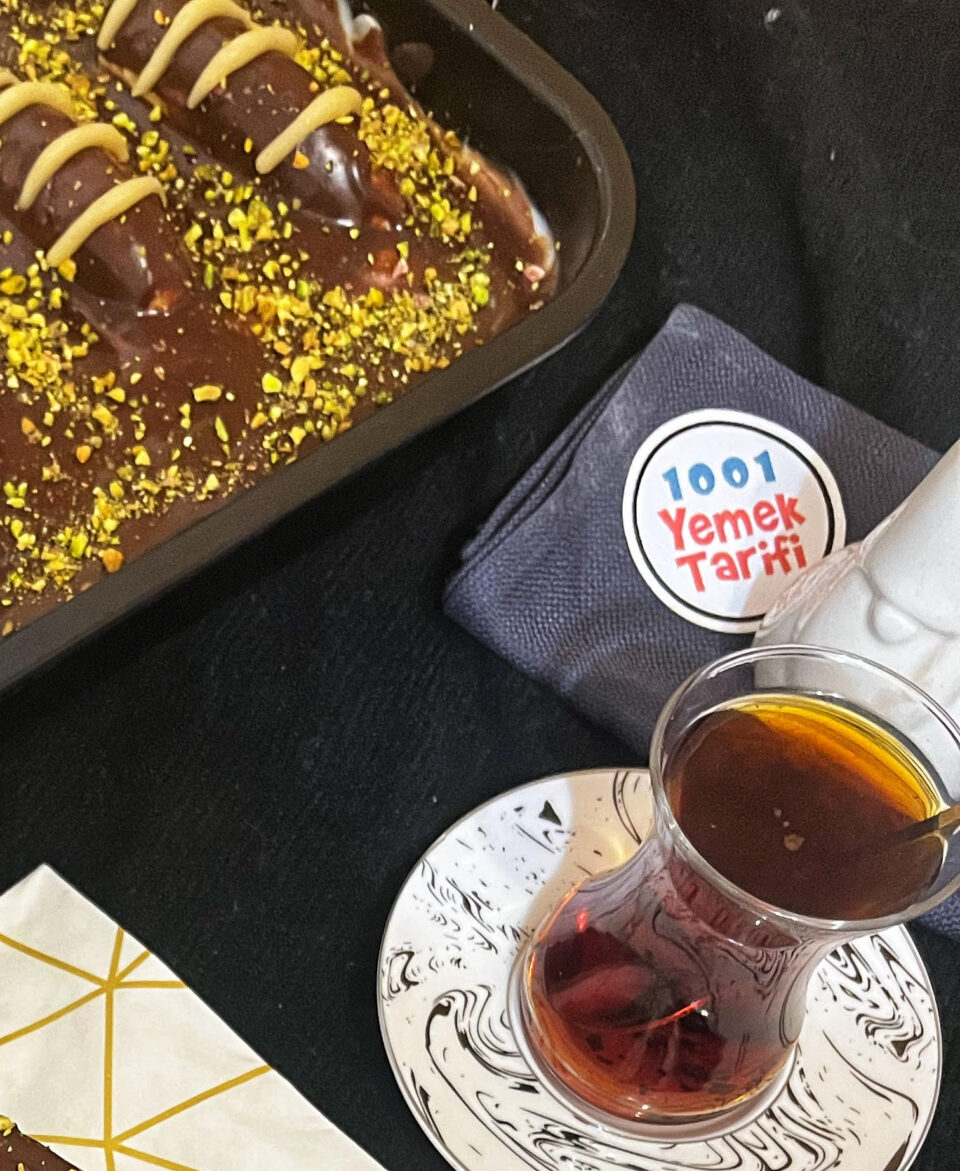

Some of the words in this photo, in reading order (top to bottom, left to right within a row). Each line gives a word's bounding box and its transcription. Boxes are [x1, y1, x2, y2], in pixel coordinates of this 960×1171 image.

[662, 450, 776, 501] 1001
[657, 494, 806, 551] Yemek
[675, 534, 807, 592] Tarifi
